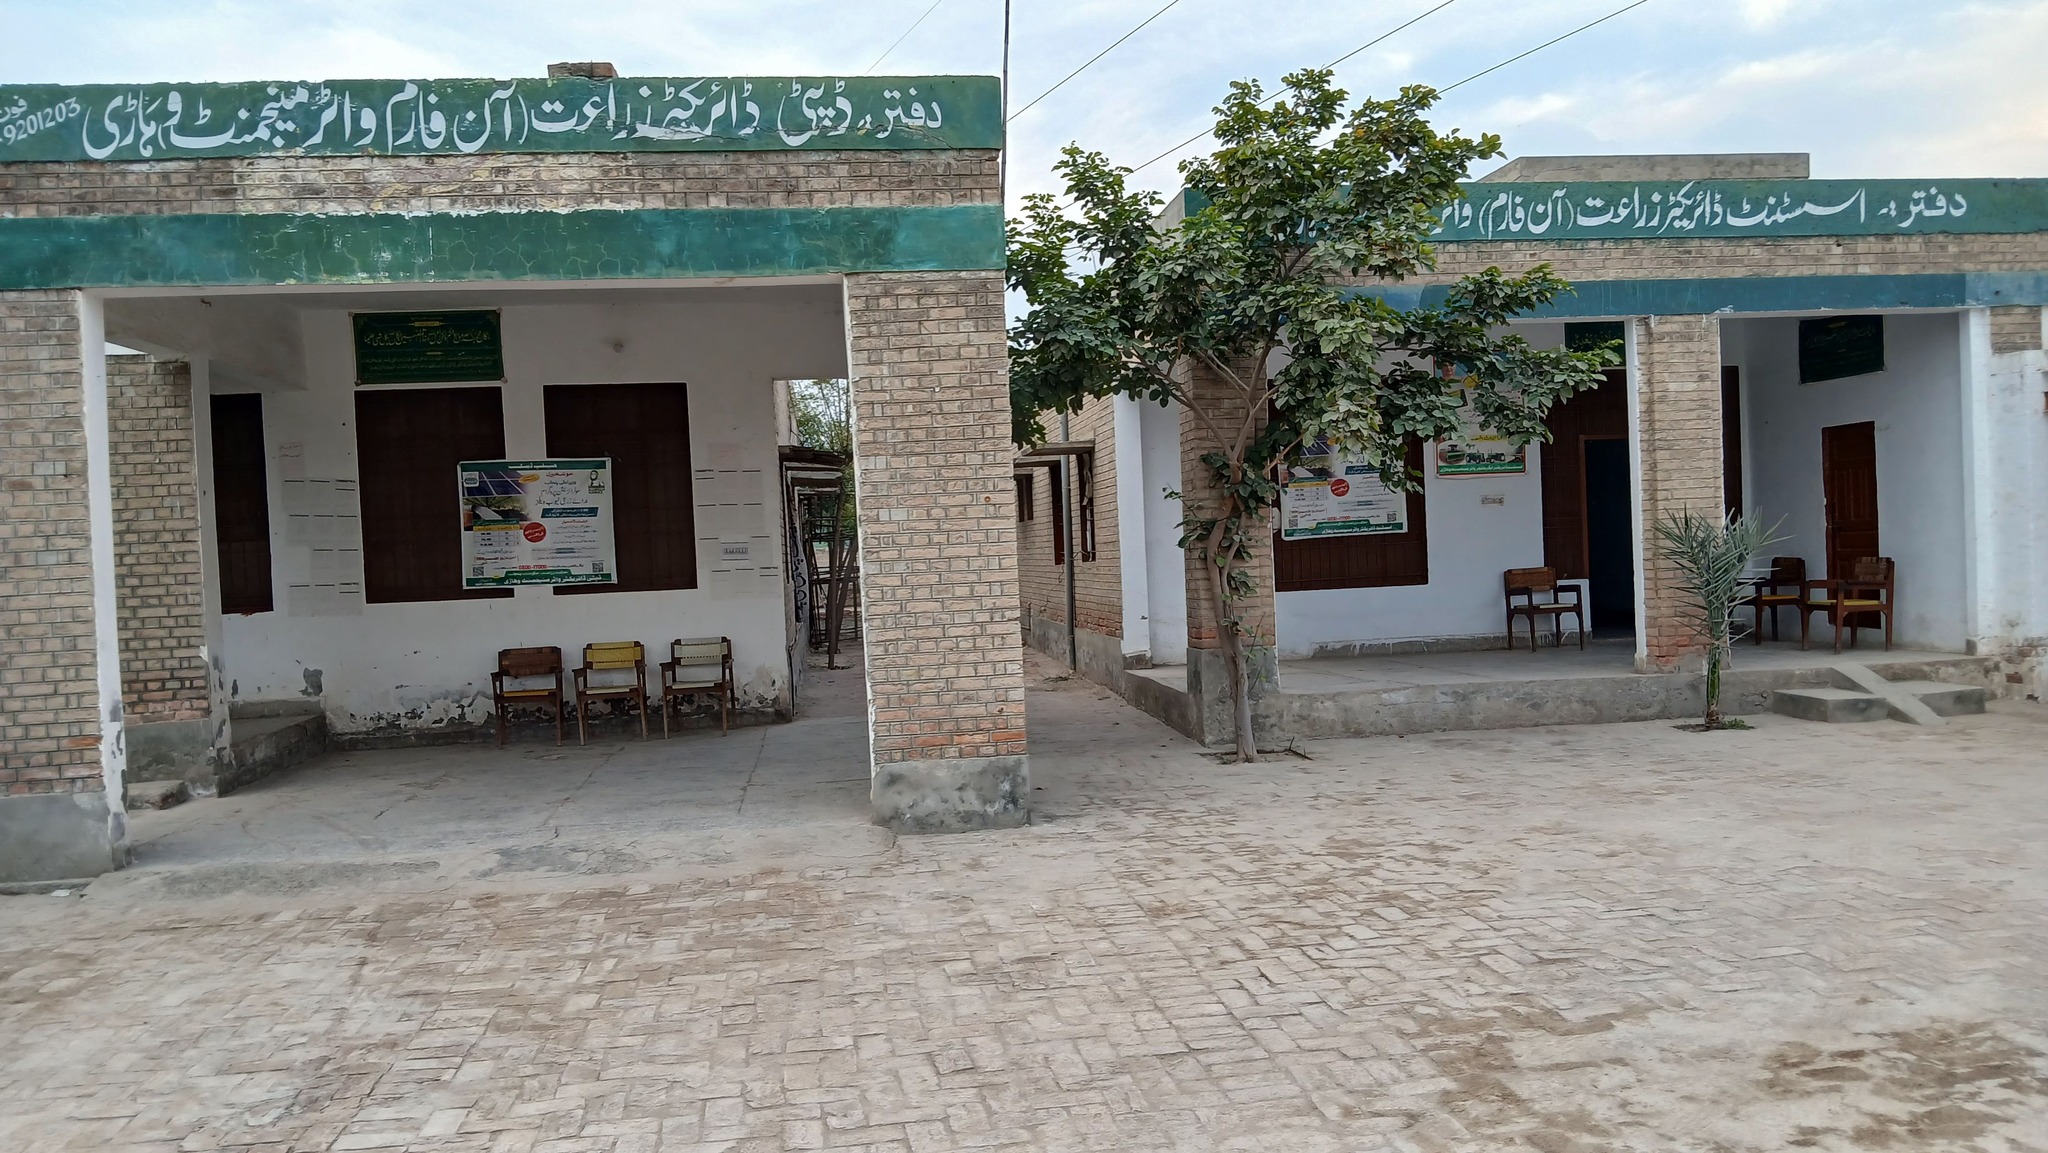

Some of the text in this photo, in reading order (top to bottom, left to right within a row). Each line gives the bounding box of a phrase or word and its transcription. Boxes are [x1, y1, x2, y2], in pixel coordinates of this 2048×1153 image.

[82, 89, 182, 159] وہاڑی
[301, 83, 376, 148] واٹر
[386, 82, 446, 155] فارم
[531, 83, 654, 140] زراعت
[777, 78, 853, 147] ڈپٹی
[1577, 187, 1663, 229] زراعت
[1656, 181, 1723, 235] ڈائریکٹر
[1726, 187, 1866, 227] اسسٹنٹ
